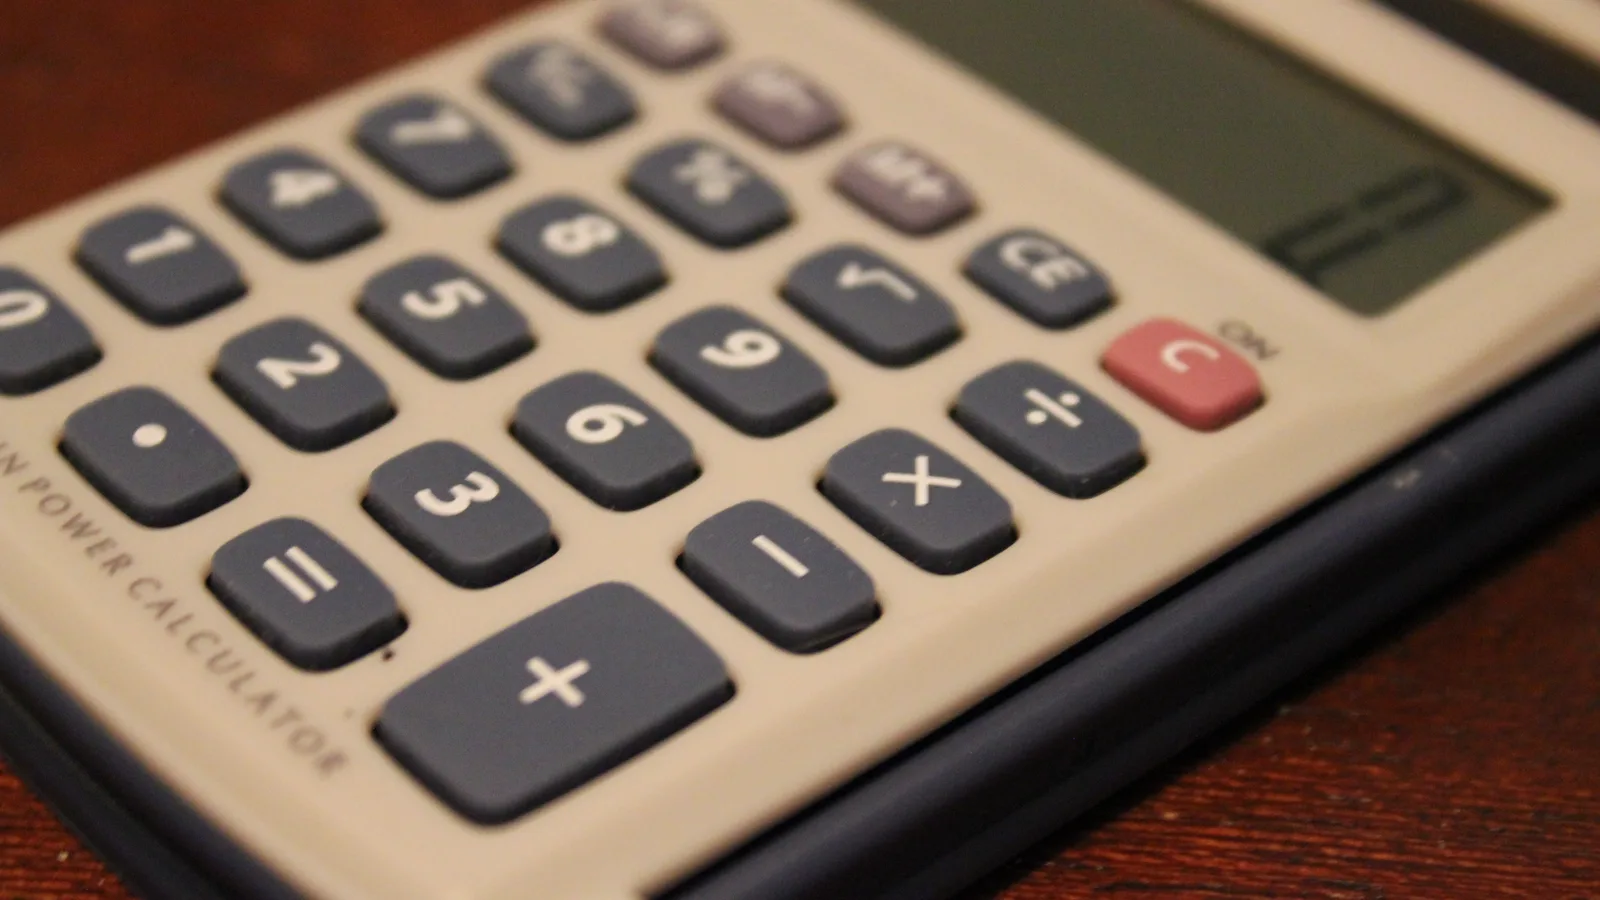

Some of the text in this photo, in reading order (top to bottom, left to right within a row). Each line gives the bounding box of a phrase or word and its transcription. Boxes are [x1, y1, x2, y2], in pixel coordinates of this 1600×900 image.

[389, 112, 469, 144] 7
[270, 170, 338, 206] 4
[126, 225, 196, 264] 1
[542, 214, 619, 256] 8
[1001, 237, 1087, 289] CE
[0, 290, 48, 328] 0
[401, 279, 487, 319] 5
[701, 329, 781, 367] 9
[1160, 339, 1220, 373] C
[1217, 321, 1280, 361] ON
[256, 342, 341, 389] 2
[566, 403, 648, 444] 6
[414, 471, 500, 516] 3
[17, 476, 134, 577] POWER
[127, 576, 348, 778] CALCULATOR
